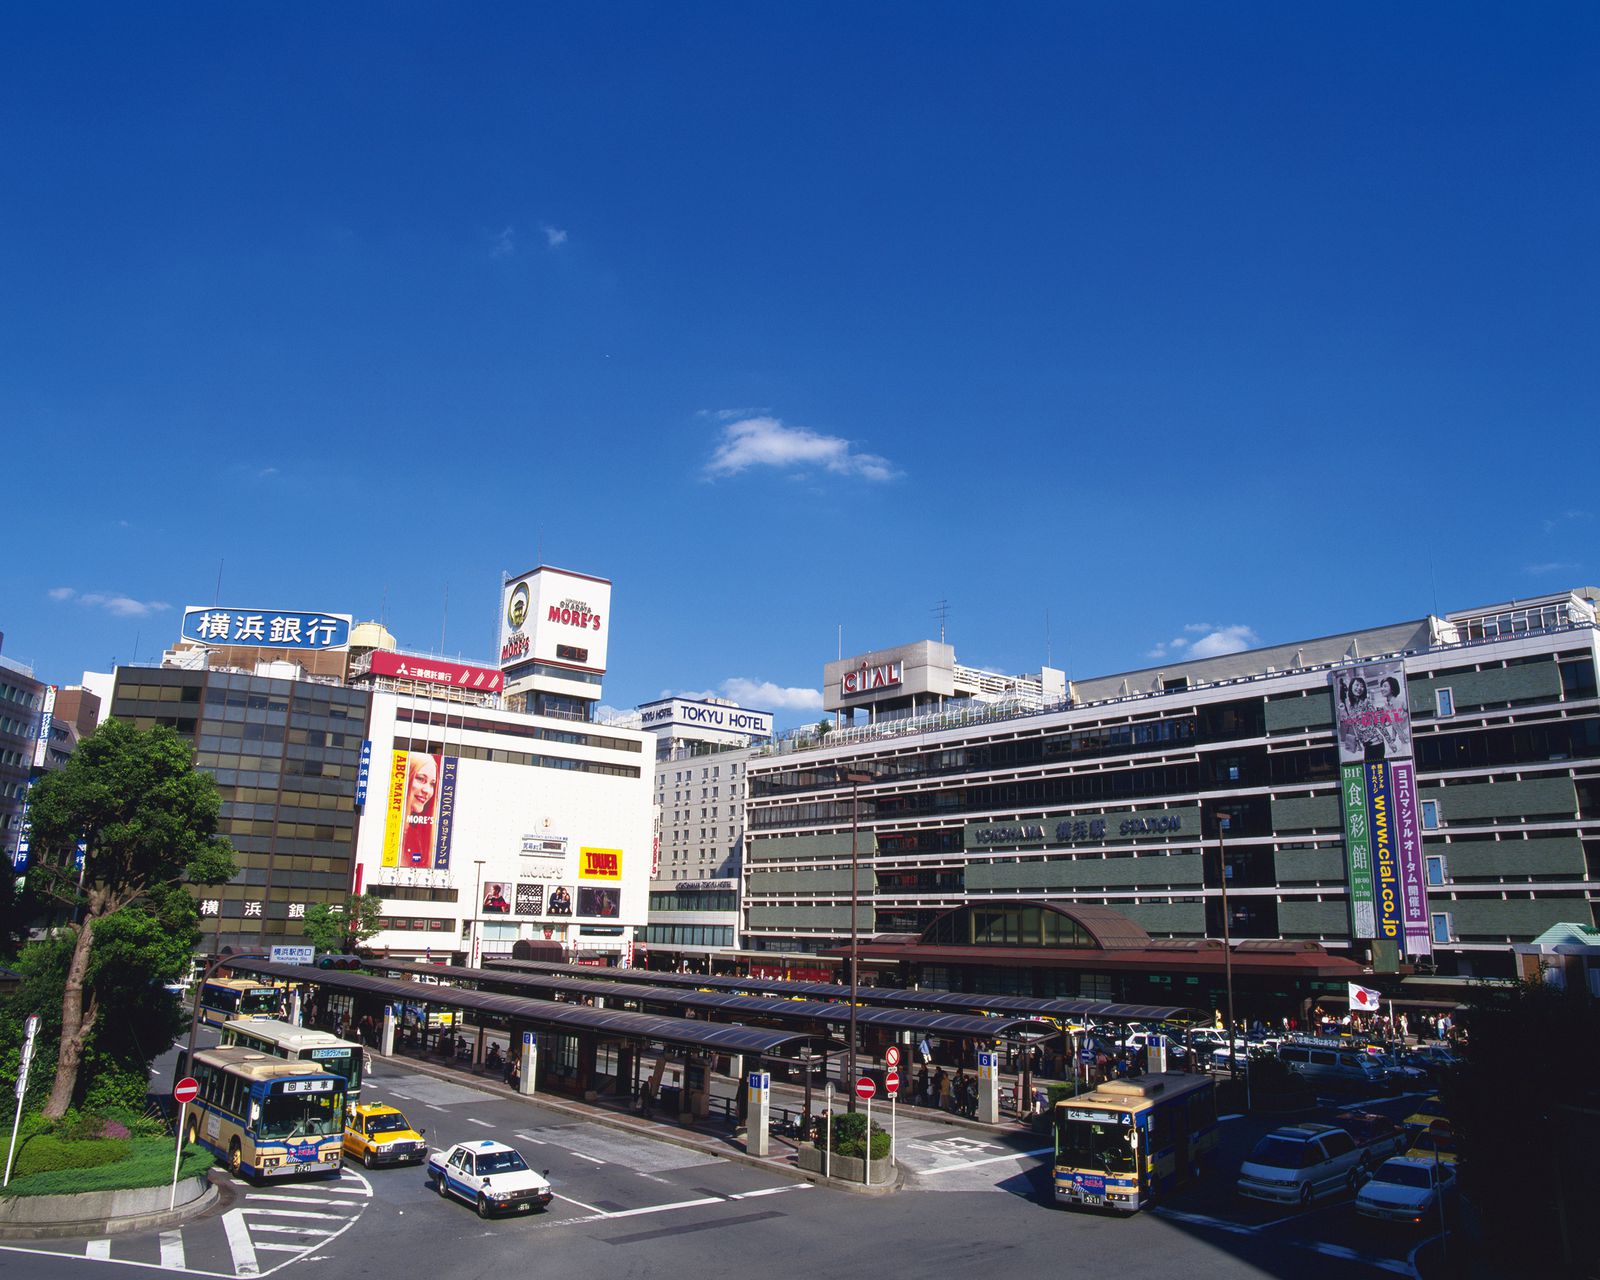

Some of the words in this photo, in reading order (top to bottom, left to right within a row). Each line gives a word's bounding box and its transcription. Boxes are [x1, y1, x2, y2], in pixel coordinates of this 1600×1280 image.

[196, 613, 337, 645] 横浜銀行
[548, 606, 601, 631] MORE'S
[410, 667, 452, 681] 三菱信託銀行
[681, 706, 723, 724] TOKYU
[729, 713, 767, 731] HOTEL
[393, 755, 406, 811] ABC-MART
[1344, 767, 1362, 778] B1F
[441, 785, 454, 817] STOCK
[406, 815, 434, 824] MORE'S
[976, 825, 1045, 844] YOKOHAMA
[1056, 818, 1107, 843] 横浜駅
[1120, 815, 1181, 836] STATION
[1348, 782, 1367, 870] 食彩館
[586, 852, 618, 870] TOWER
[1374, 795, 1400, 937] www.cial.co.jp
[274, 948, 311, 956] 横浜駅西口
[982, 1055, 988, 1065] 6
[288, 1081, 329, 1091] 回送車
[752, 1075, 759, 1087] 11
